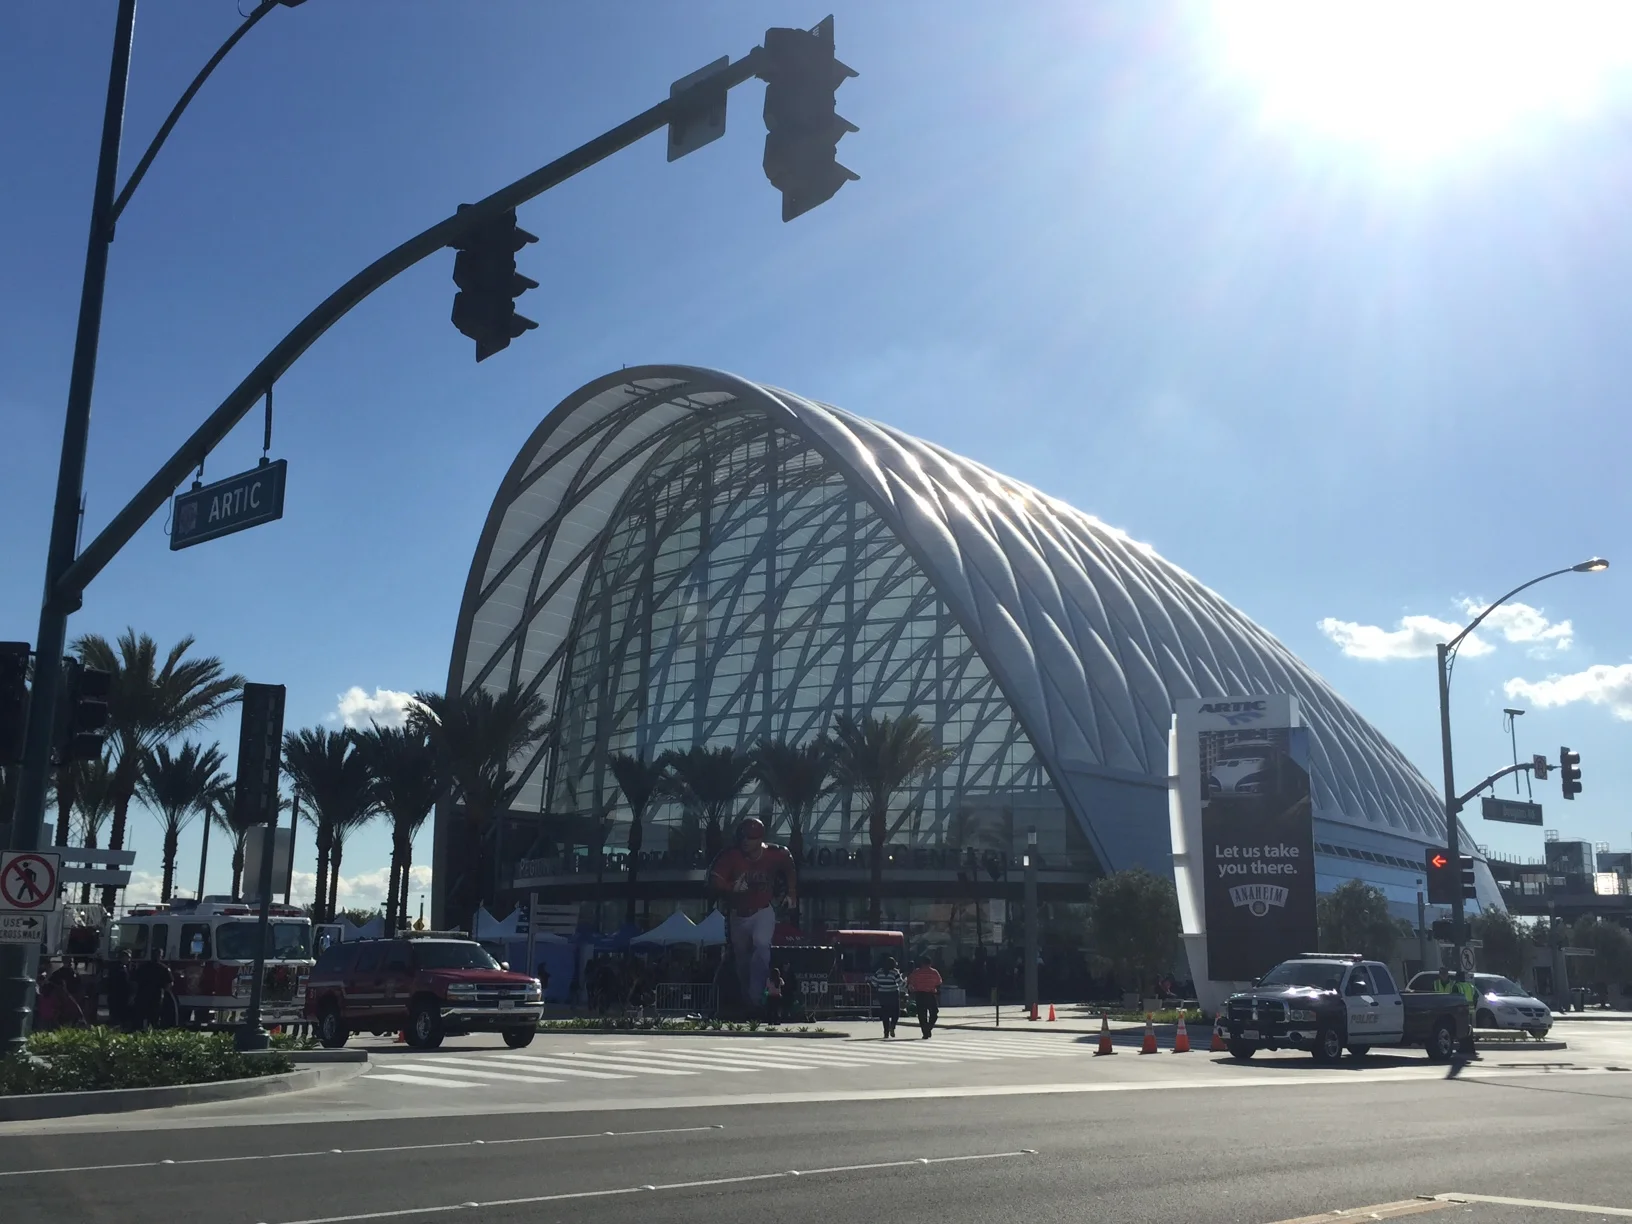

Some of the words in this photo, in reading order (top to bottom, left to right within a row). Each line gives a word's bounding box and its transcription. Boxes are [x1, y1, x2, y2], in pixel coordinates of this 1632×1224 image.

[208, 481, 261, 523] ARTIC
[1198, 700, 1267, 714] ARTIC
[1215, 845, 1239, 858] Let
[1242, 847, 1261, 858] us
[1263, 843, 1299, 857] take
[1218, 864, 1247, 878] you
[1250, 860, 1298, 874] there.
[1234, 886, 1283, 902] ANAHEIM
[3, 918, 20, 927] USE
[801, 981, 829, 994] 830
[1350, 1013, 1379, 1024] POLICE
